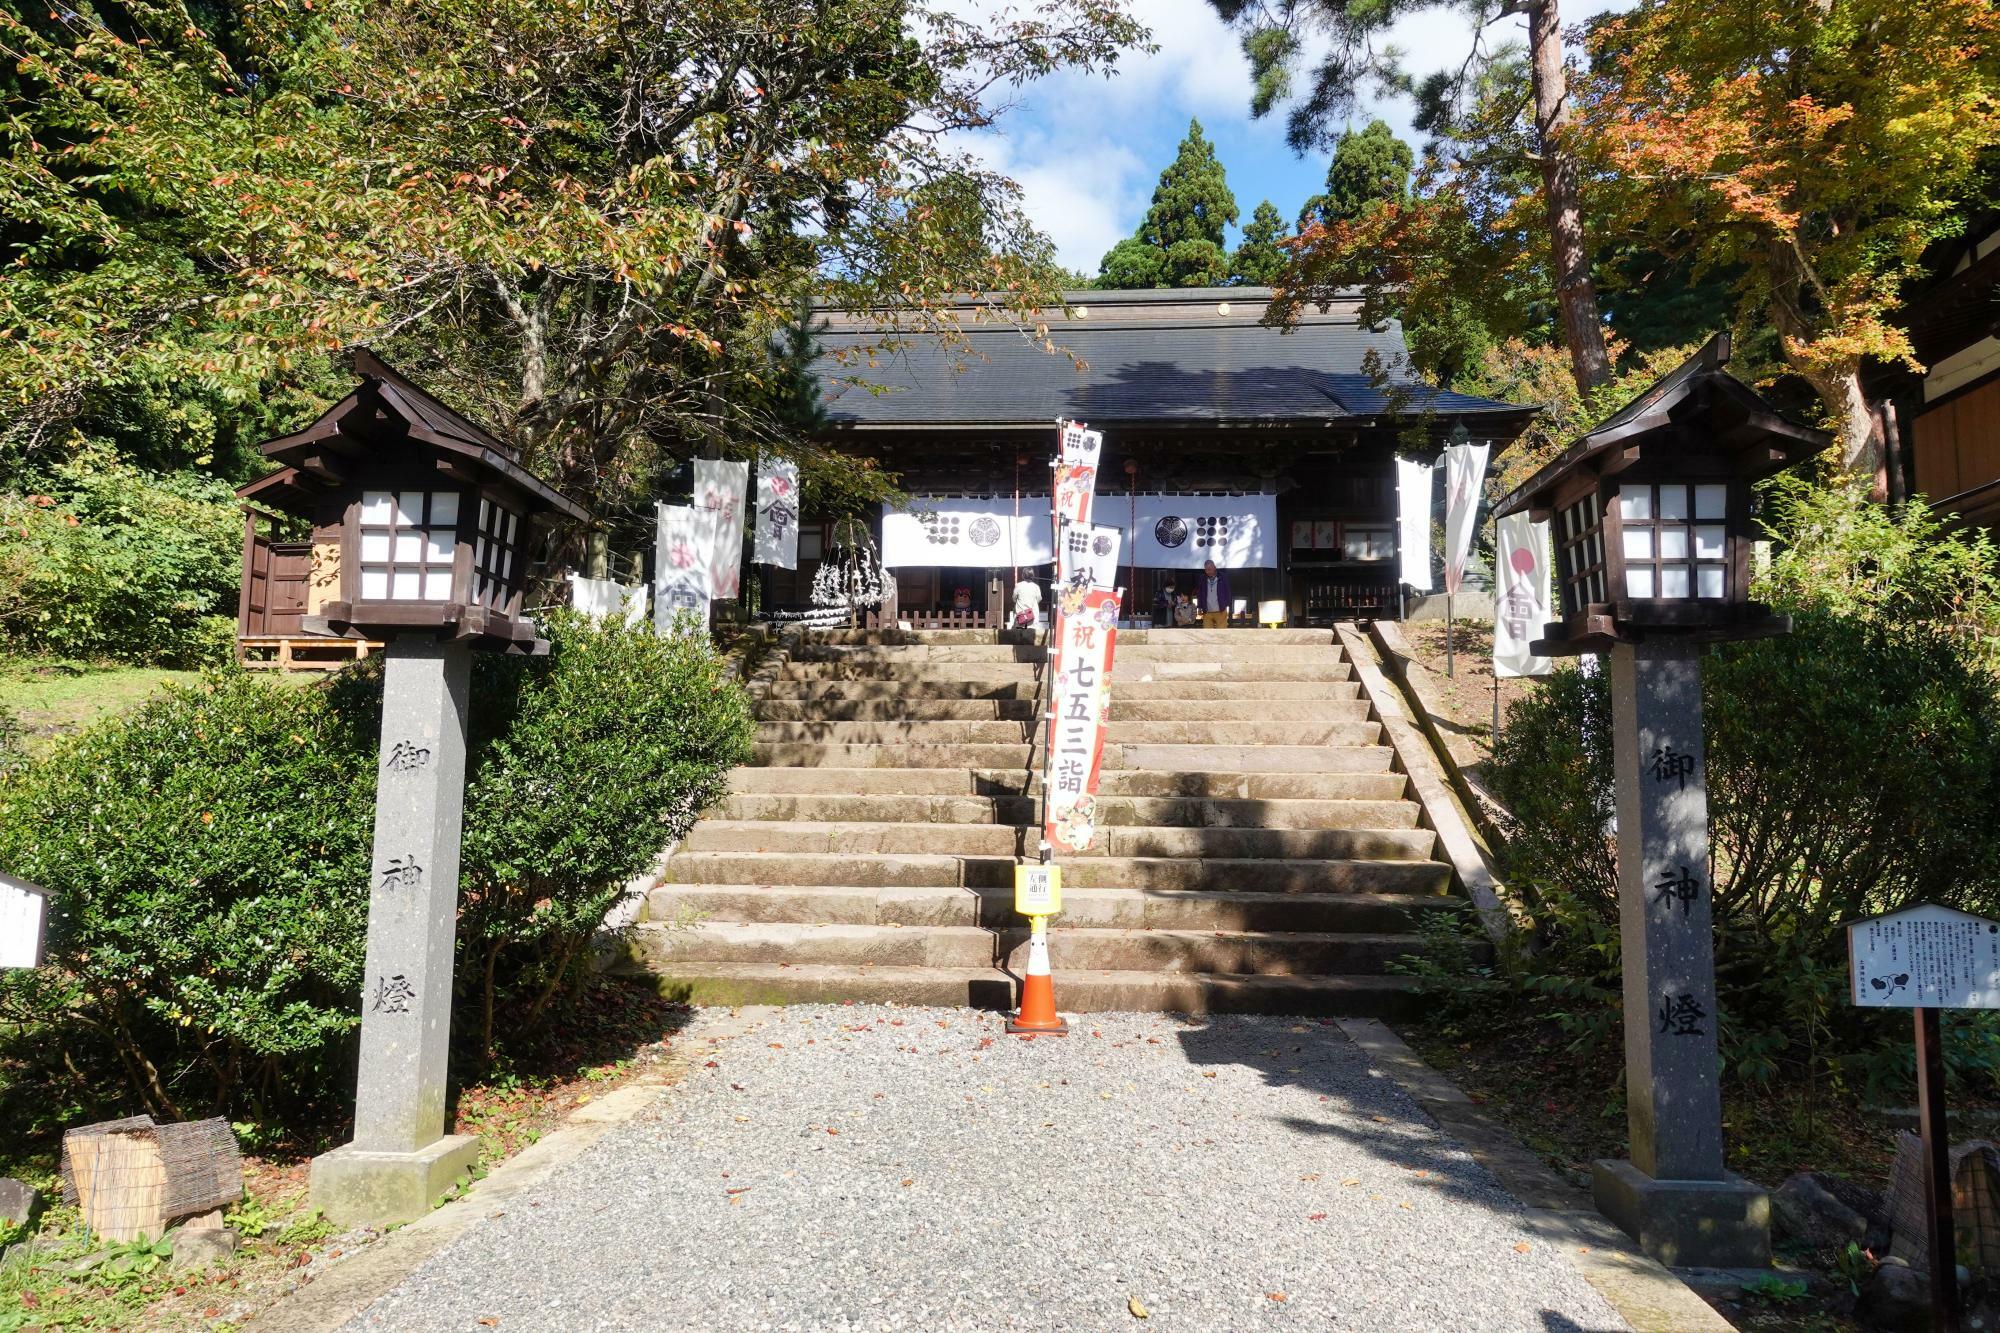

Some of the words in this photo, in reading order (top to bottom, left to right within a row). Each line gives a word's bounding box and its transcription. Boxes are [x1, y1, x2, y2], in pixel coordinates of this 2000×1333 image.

[1060, 487, 1074, 508] 祝
[1647, 745, 1708, 1036] 御神燈
